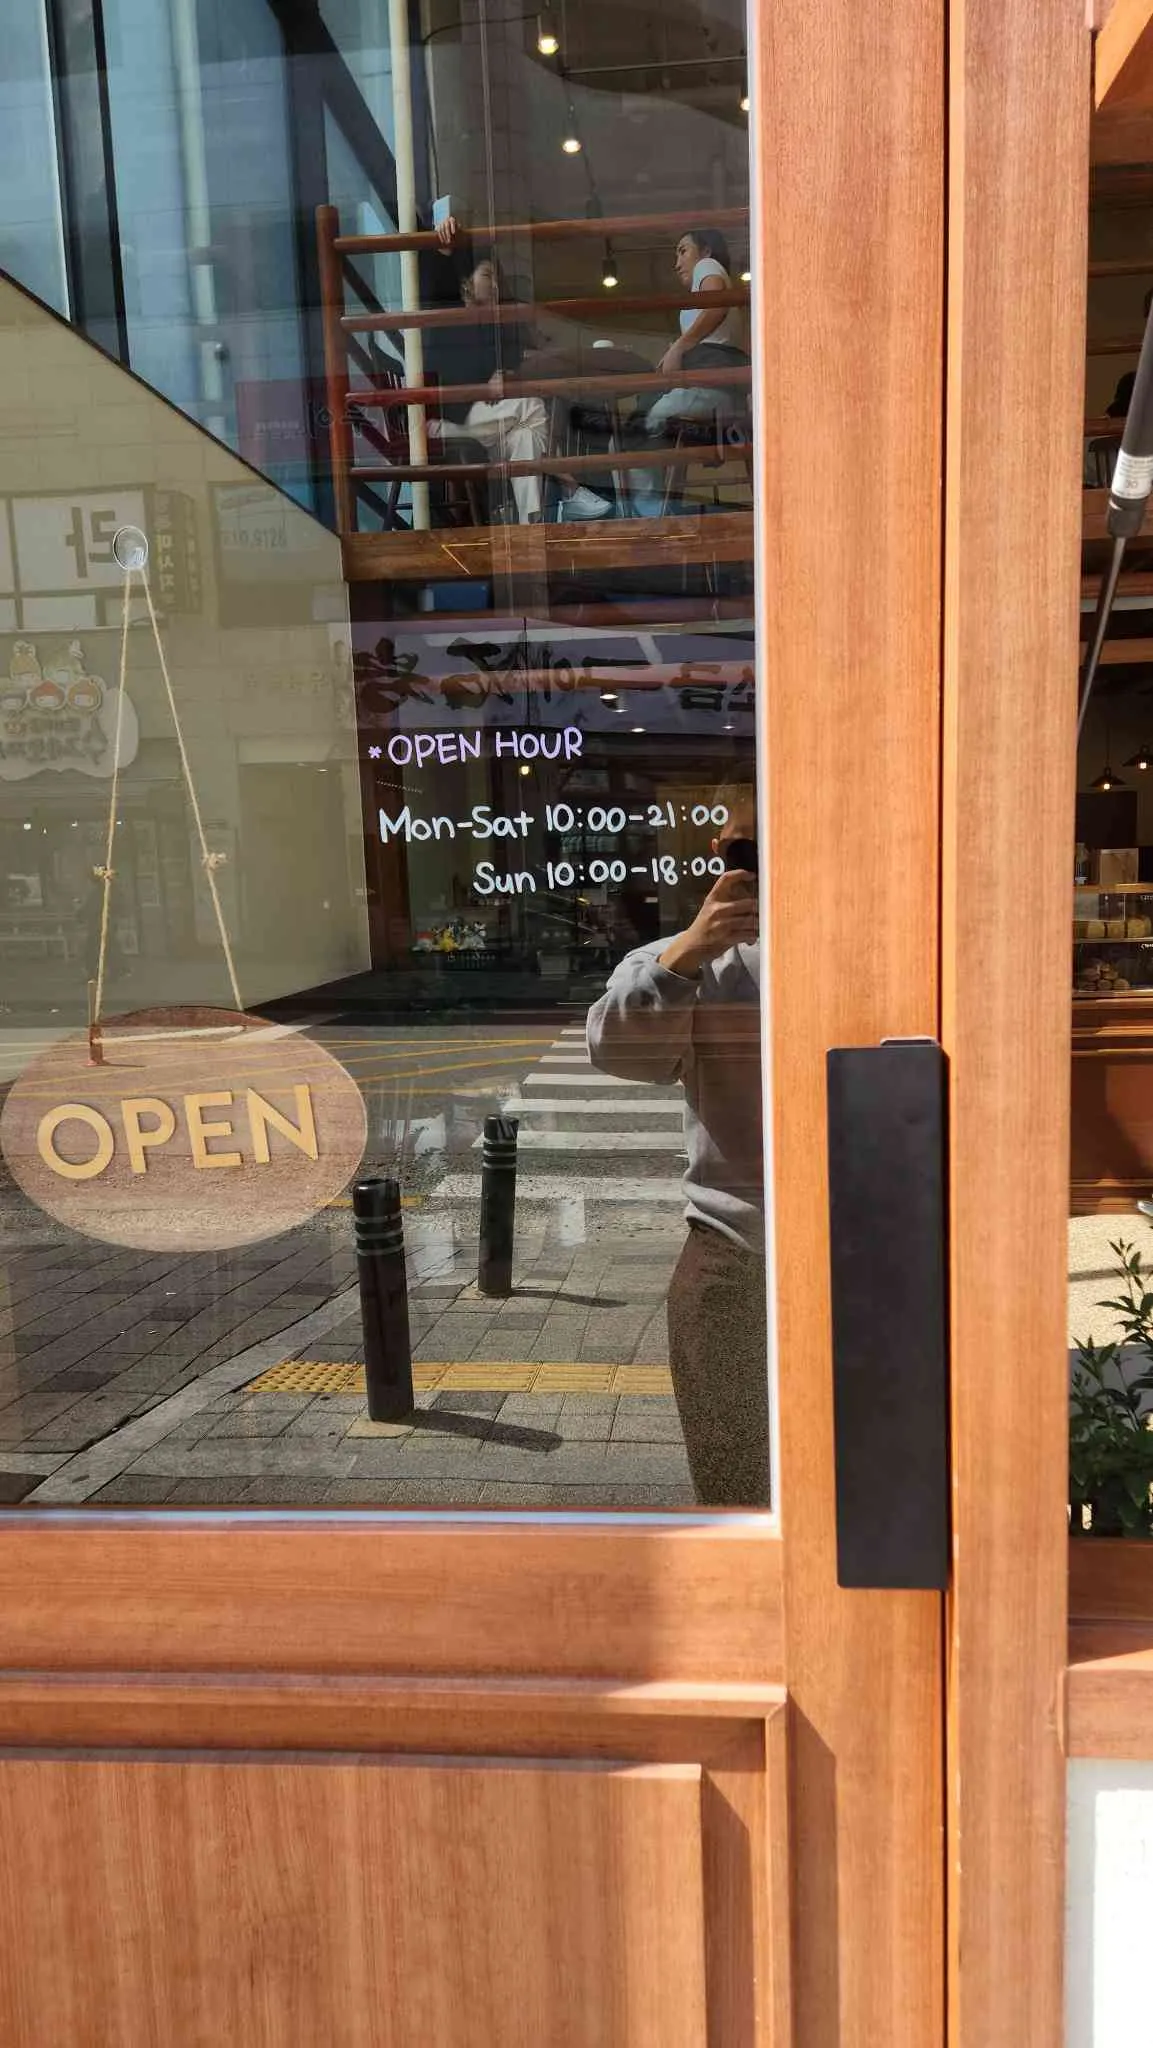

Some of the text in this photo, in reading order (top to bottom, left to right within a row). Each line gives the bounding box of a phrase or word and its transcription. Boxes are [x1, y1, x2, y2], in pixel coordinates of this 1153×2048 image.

[387, 726, 583, 768] OPEN HOUR
[379, 801, 729, 843] Mon-Sat 10:00-21:00
[473, 855, 728, 894] Sun 10:00-18:00
[37, 1083, 319, 1180] OPEN
